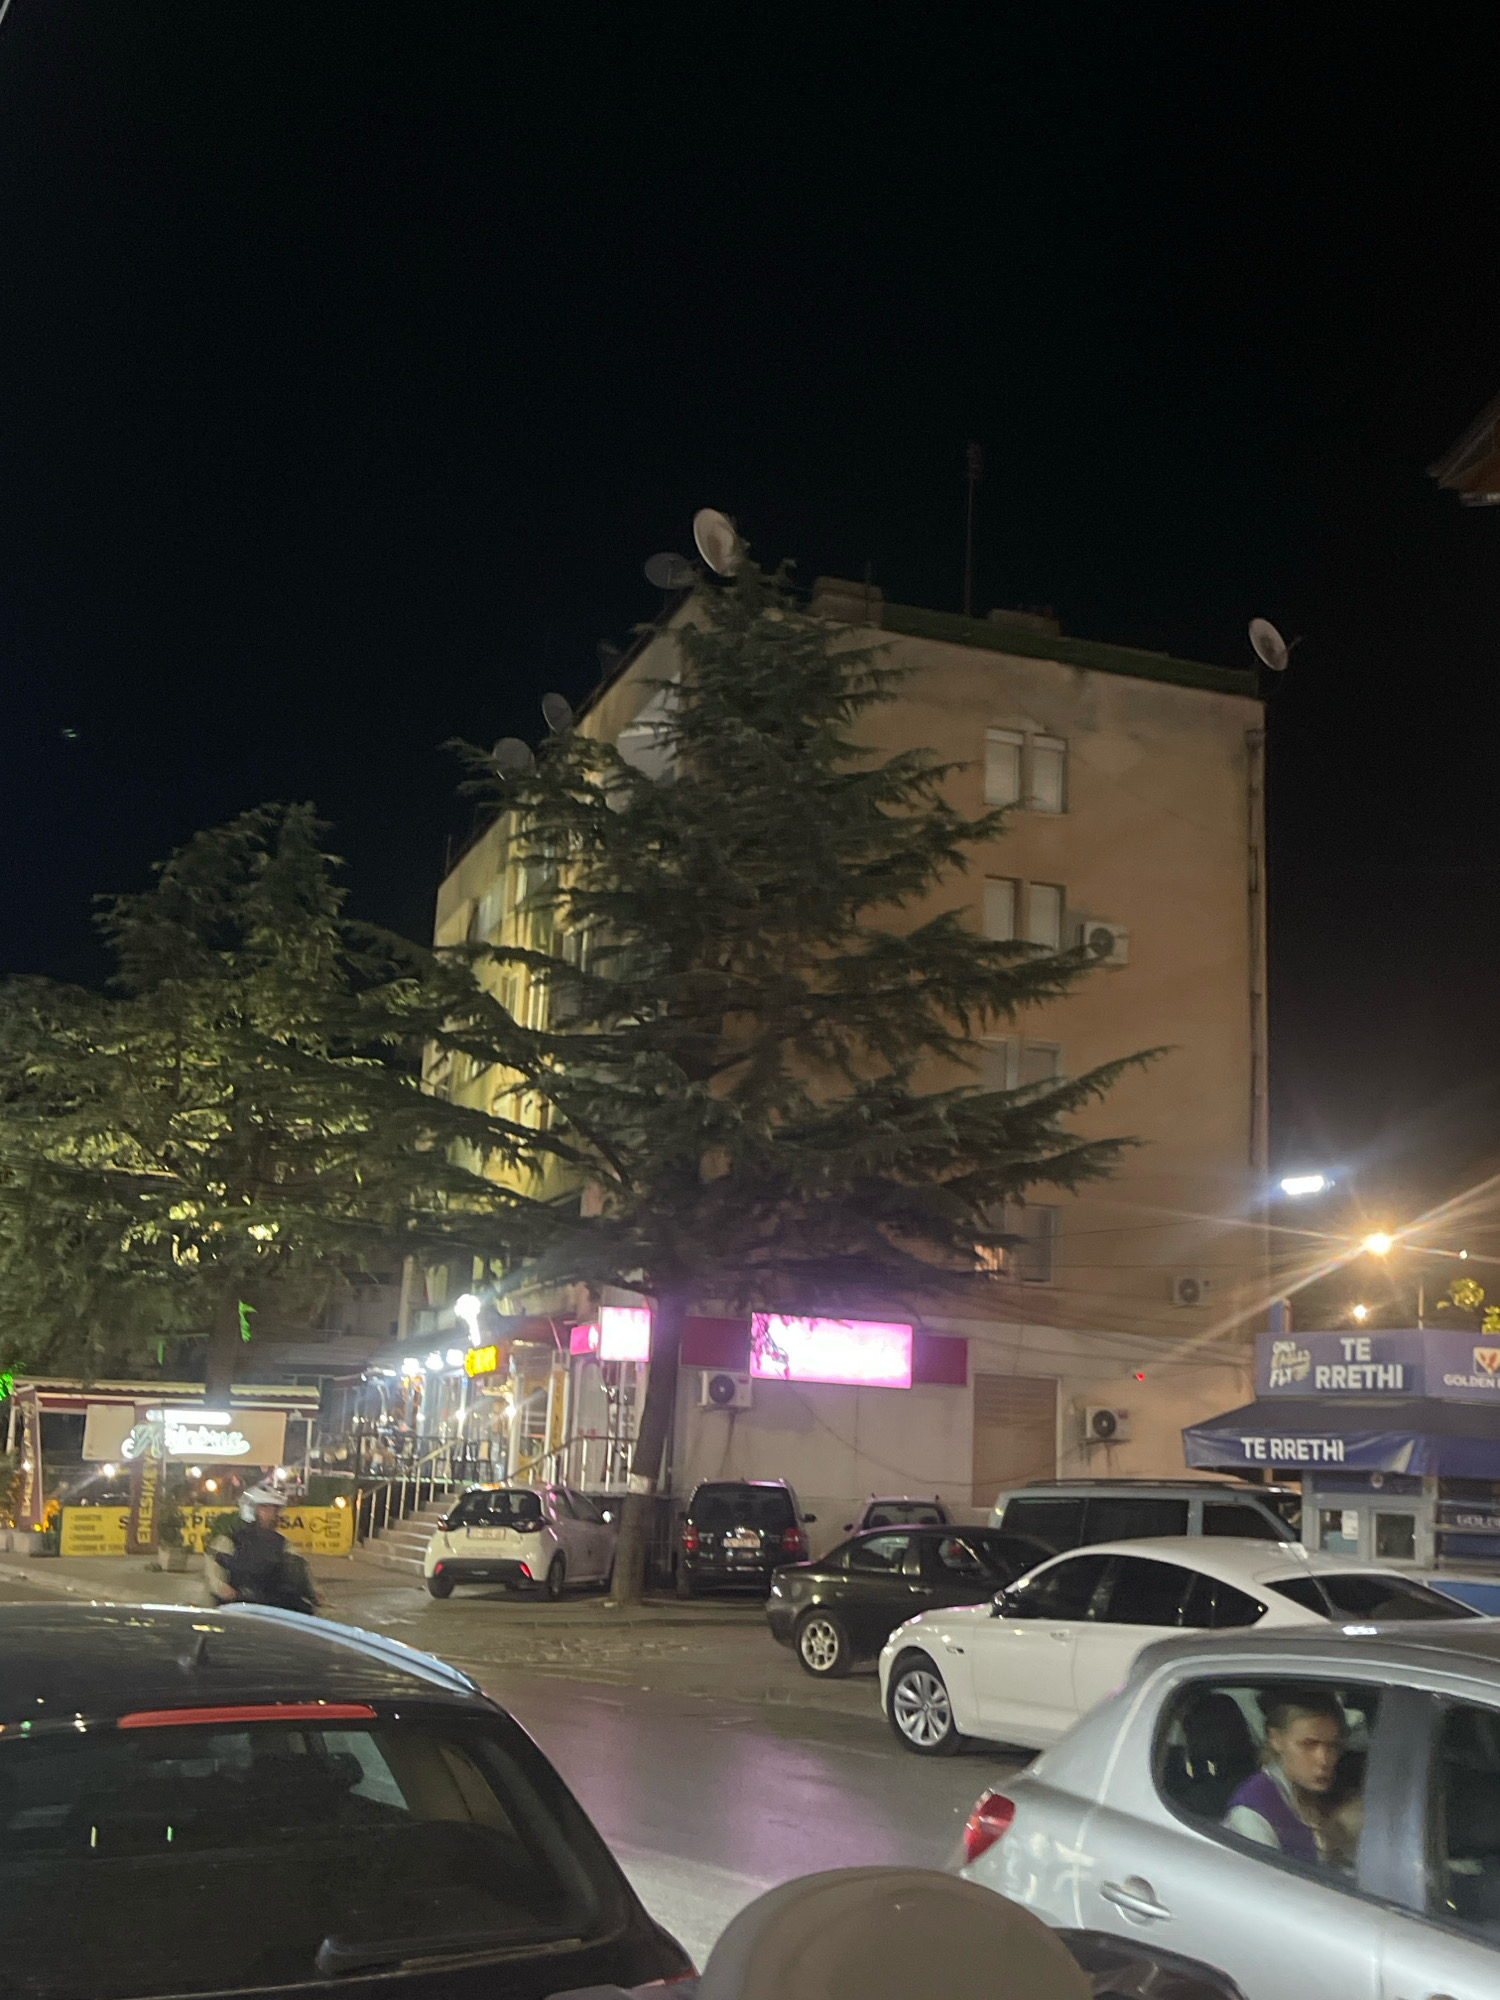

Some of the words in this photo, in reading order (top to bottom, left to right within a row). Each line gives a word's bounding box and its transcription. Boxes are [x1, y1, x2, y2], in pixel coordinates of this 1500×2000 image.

[1340, 1337, 1371, 1362] TE
[1269, 1367, 1292, 1389] FLY
[1315, 1364, 1403, 1389] RRETHI
[1443, 1373, 1495, 1389] GOLDEN
[1240, 1437, 1267, 1460] TE
[1270, 1437, 1344, 1462] RRETHI
